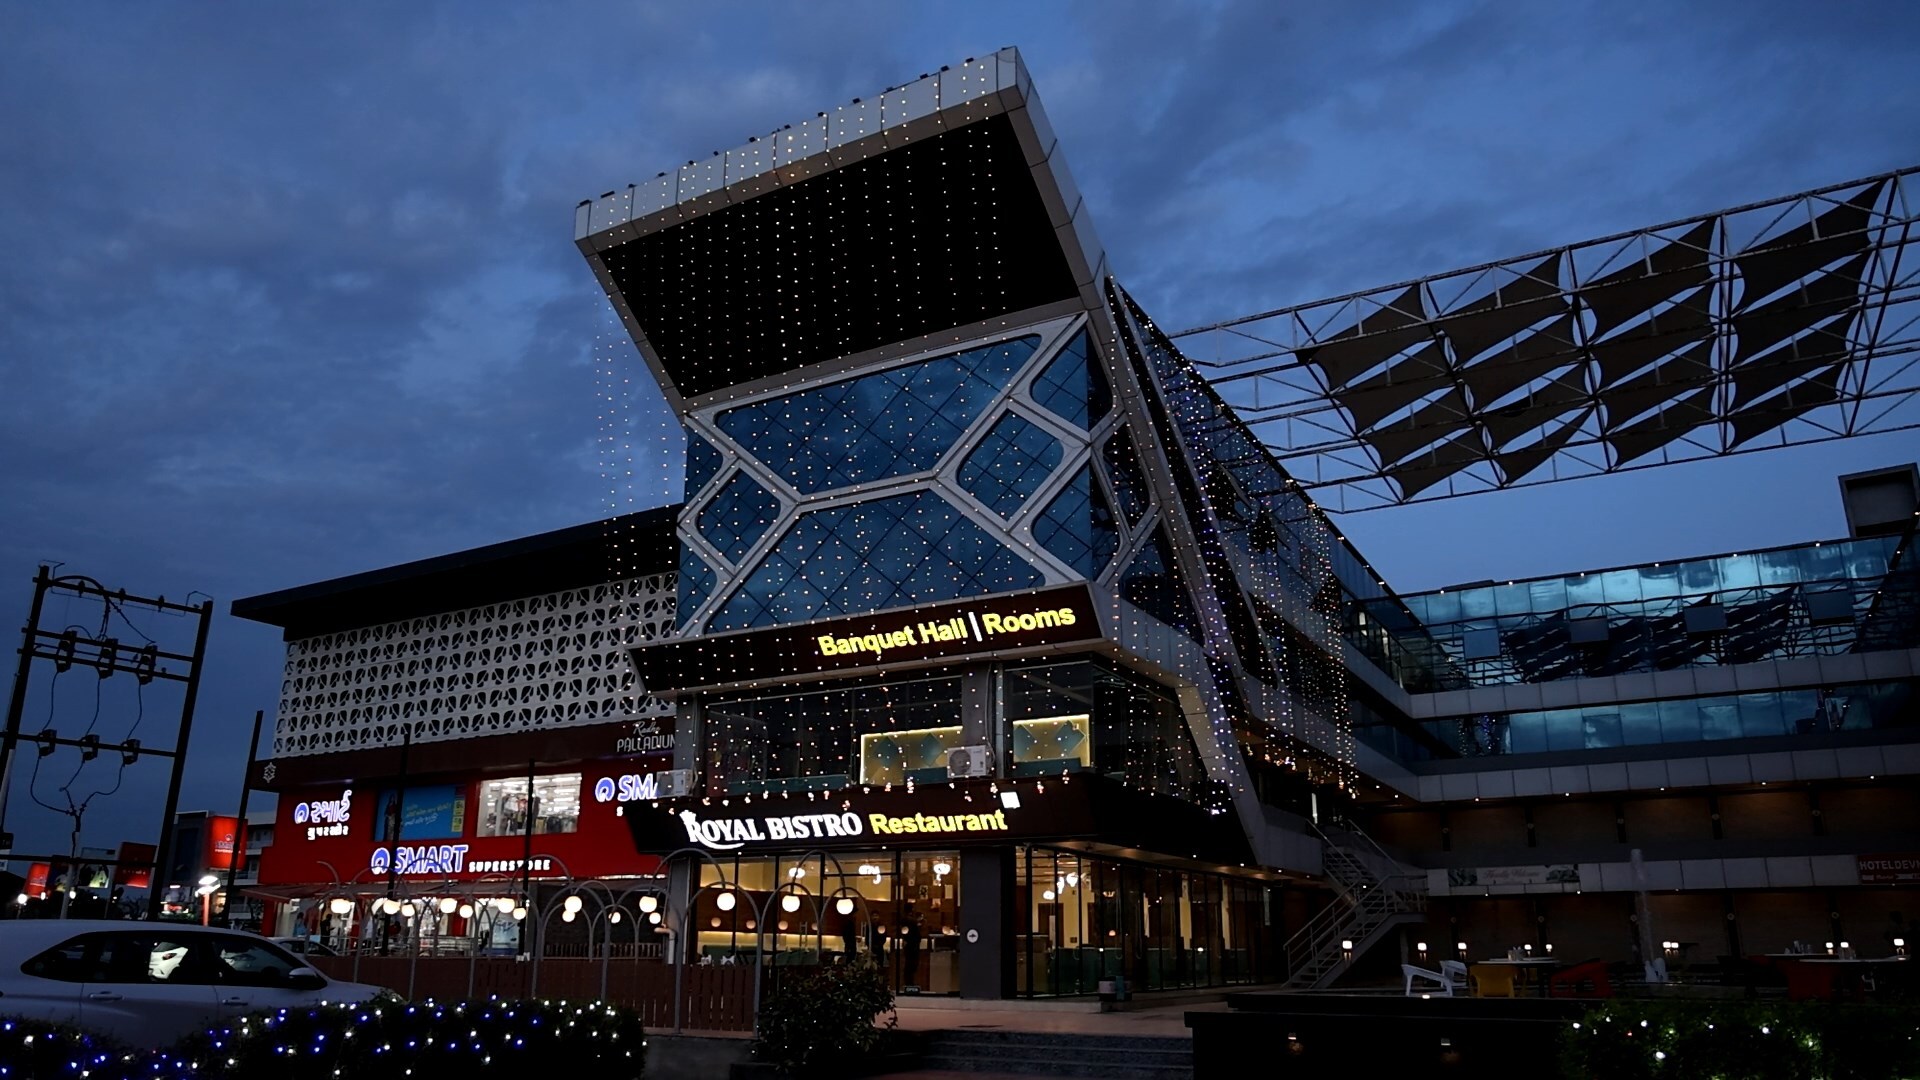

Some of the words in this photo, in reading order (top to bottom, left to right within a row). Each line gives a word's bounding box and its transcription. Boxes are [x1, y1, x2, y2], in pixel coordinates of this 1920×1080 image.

[817, 625, 918, 656] Banquet
[918, 617, 969, 644] Hall
[982, 608, 1076, 635] Rooms
[679, 809, 766, 849] ROYAL
[764, 812, 863, 840] BISTRO
[868, 808, 1008, 835] Restaurant
[394, 844, 469, 875] SMART
[468, 859, 551, 873] SUPERSTORE
